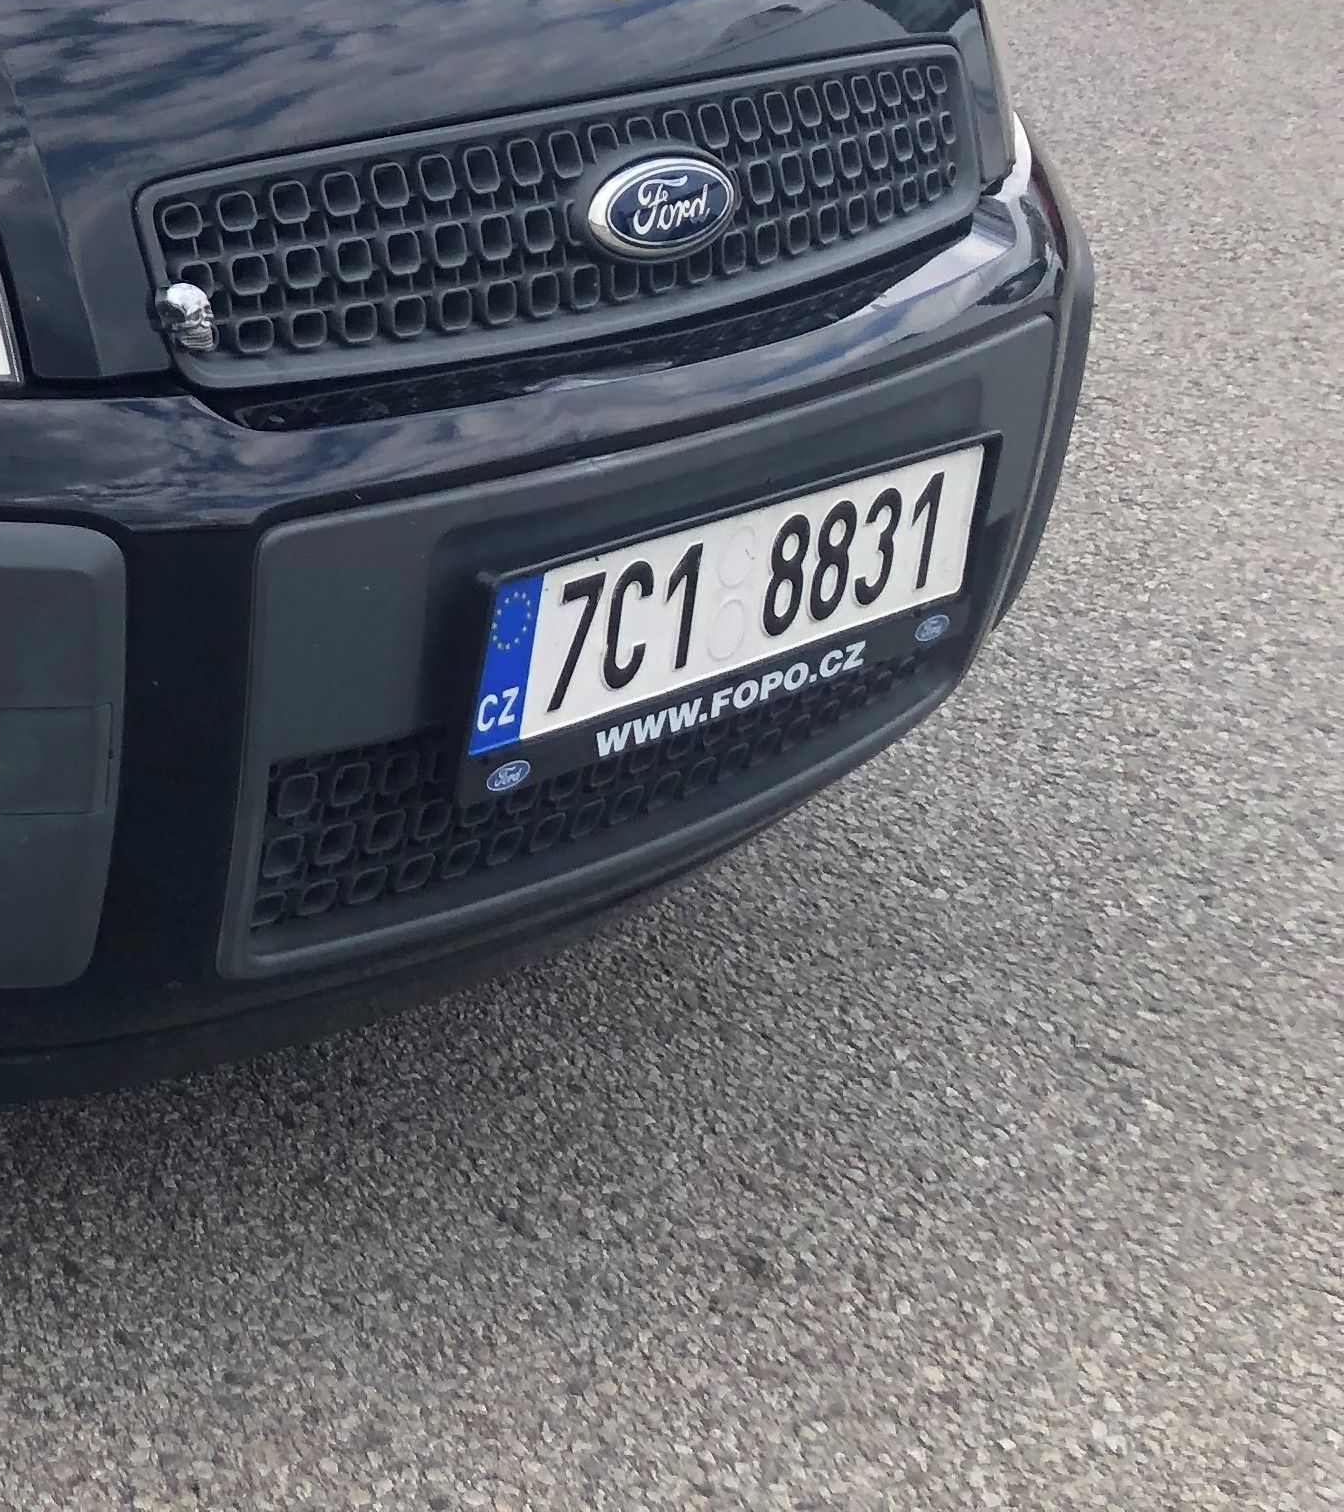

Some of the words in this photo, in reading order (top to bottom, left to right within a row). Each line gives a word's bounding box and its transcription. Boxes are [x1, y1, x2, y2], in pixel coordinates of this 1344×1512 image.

[633, 174, 710, 235] Ford
[546, 542, 703, 713] 7C1
[762, 471, 945, 637] 8831
[477, 687, 519, 731] CZ
[595, 640, 866, 757] WWW.FOPO.CZ
